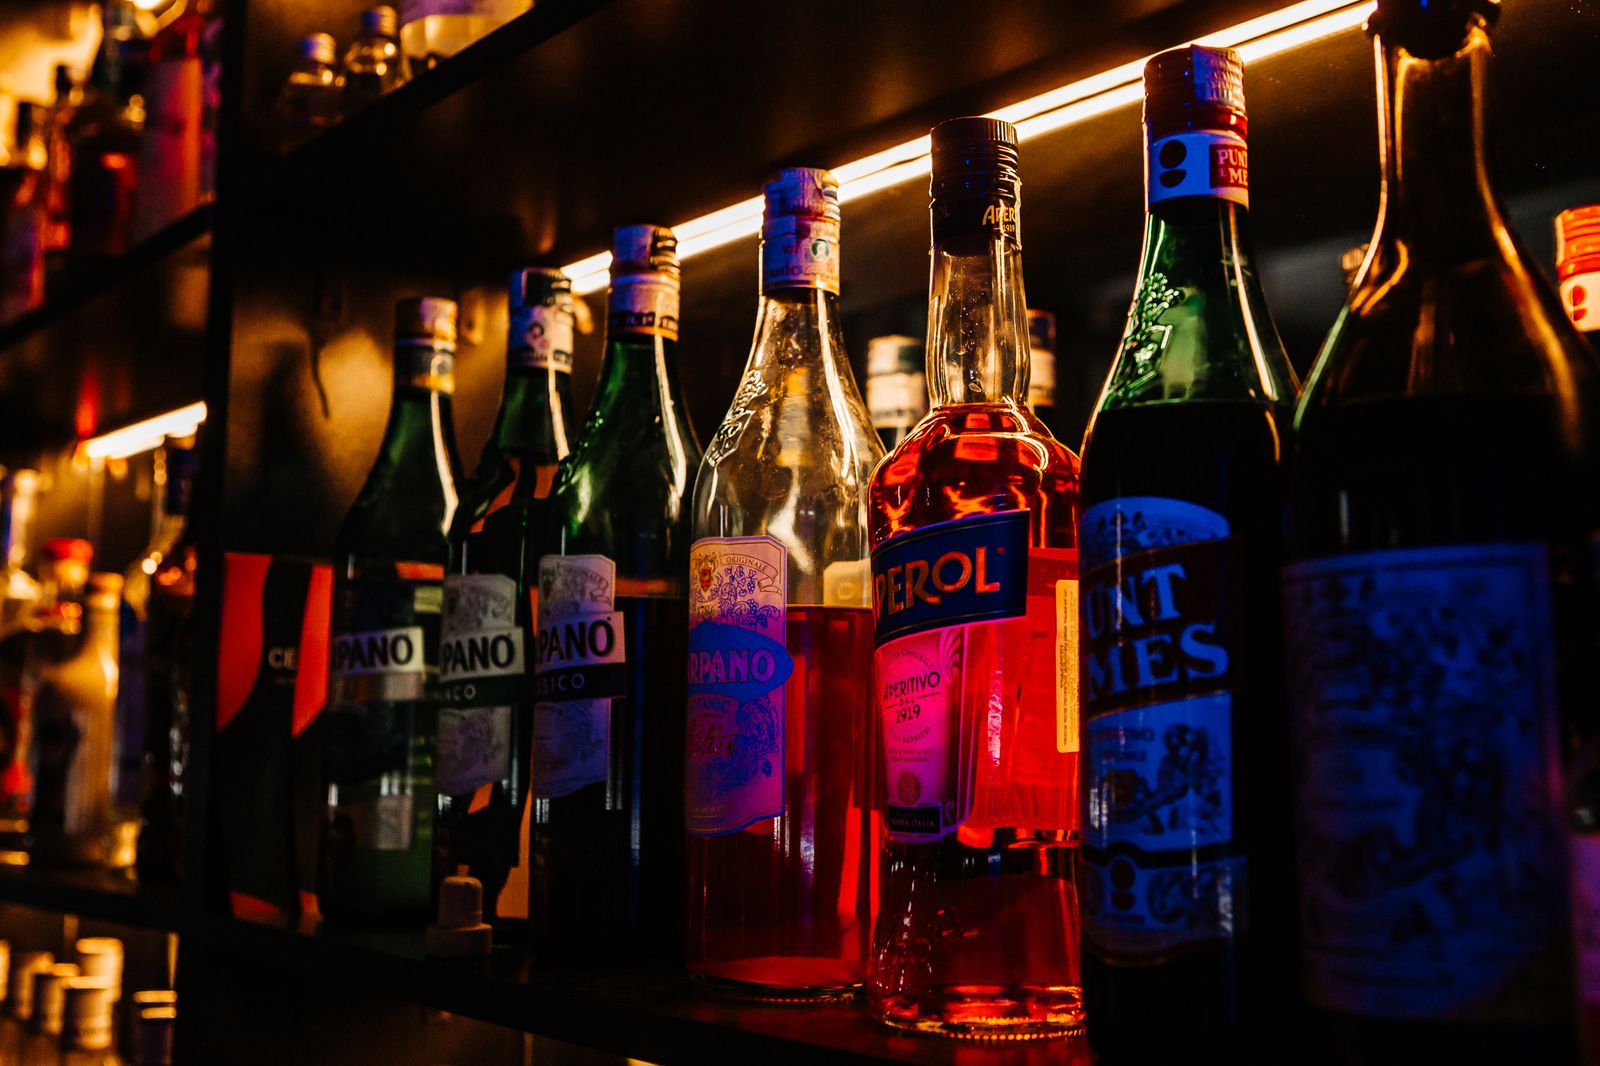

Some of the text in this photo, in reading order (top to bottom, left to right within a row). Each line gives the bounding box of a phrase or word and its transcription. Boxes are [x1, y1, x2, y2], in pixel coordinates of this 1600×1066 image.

[726, 555, 768, 573] ORIGINALE
[883, 671, 941, 701] APERITIVO
[895, 703, 921, 724] 1919
